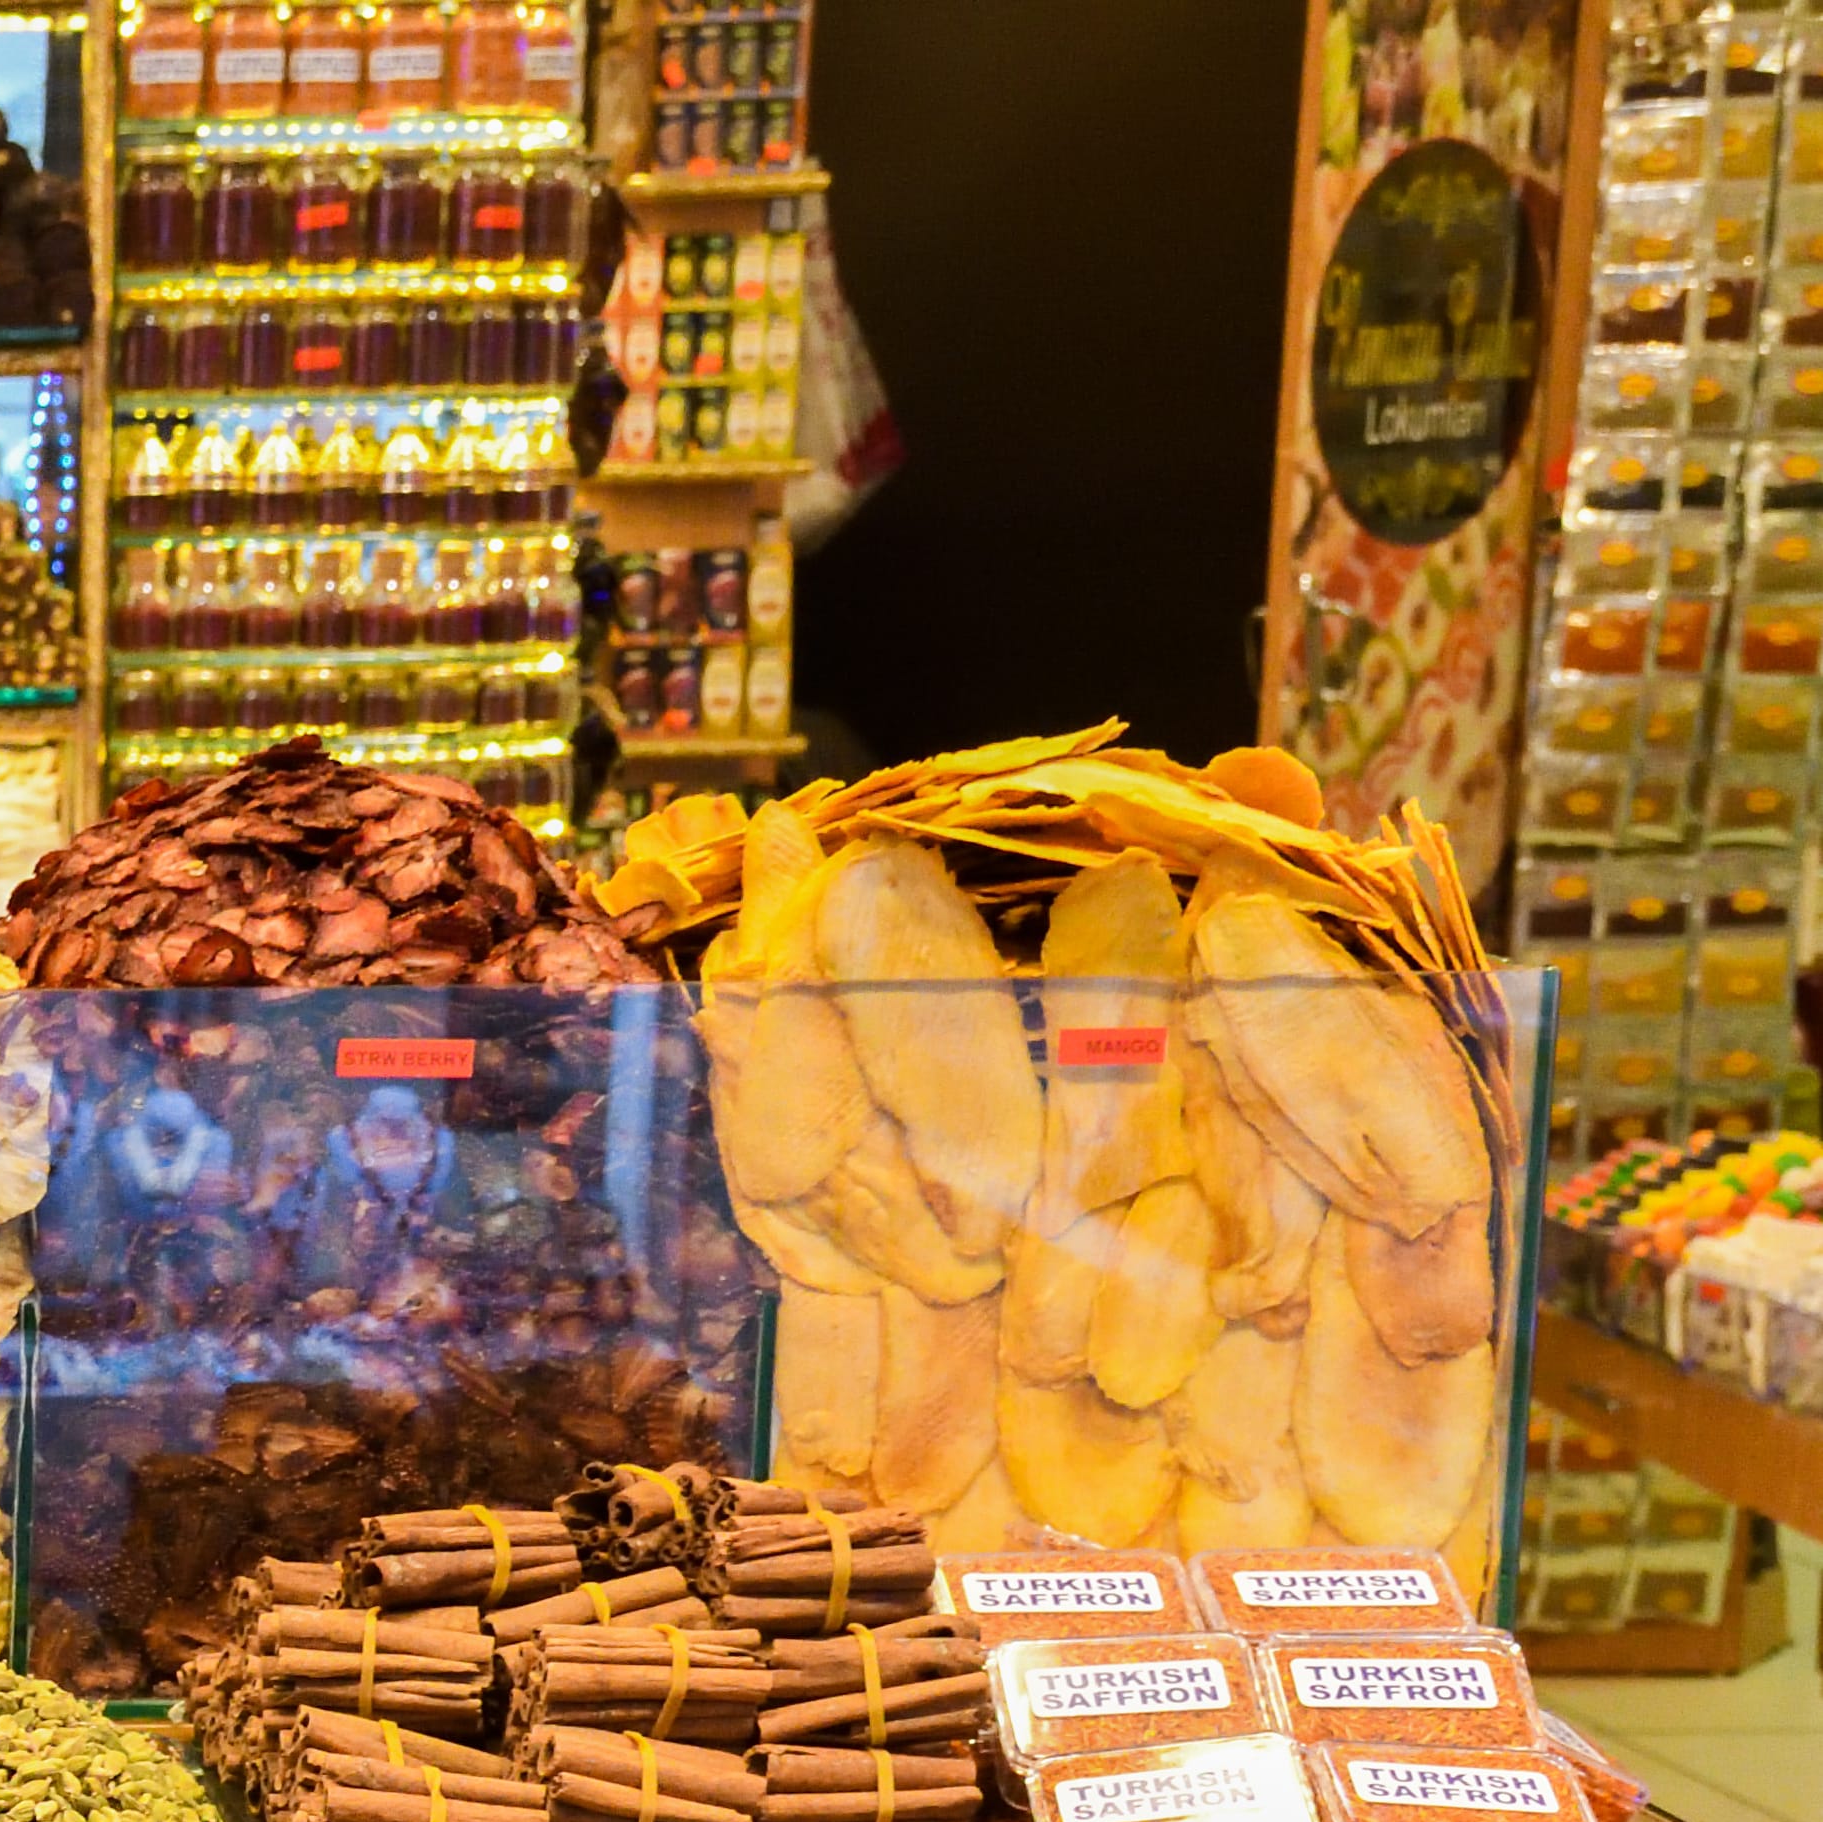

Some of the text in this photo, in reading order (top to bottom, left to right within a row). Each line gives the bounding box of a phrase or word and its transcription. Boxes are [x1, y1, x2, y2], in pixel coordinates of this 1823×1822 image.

[1086, 1039, 1159, 1054] MANGO
[343, 1051, 468, 1066] STRW BERRY
[976, 1577, 1145, 1591] TURKISH
[1248, 1575, 1418, 1588] TURKISH
[980, 1593, 1153, 1606] SAFFRON
[1252, 1589, 1428, 1601] SAFFRON
[1039, 1667, 1211, 1690] TURKISH
[1305, 1666, 1479, 1682] TURKISH
[1042, 1686, 1219, 1710] SAFFRON
[1309, 1685, 1487, 1700] SAFFRON
[1069, 1768, 1248, 1801] TURKISH
[1362, 1767, 1538, 1791] TURKISH
[1367, 1783, 1547, 1807] SAFFRON
[1073, 1787, 1255, 1820] SAFFRON
